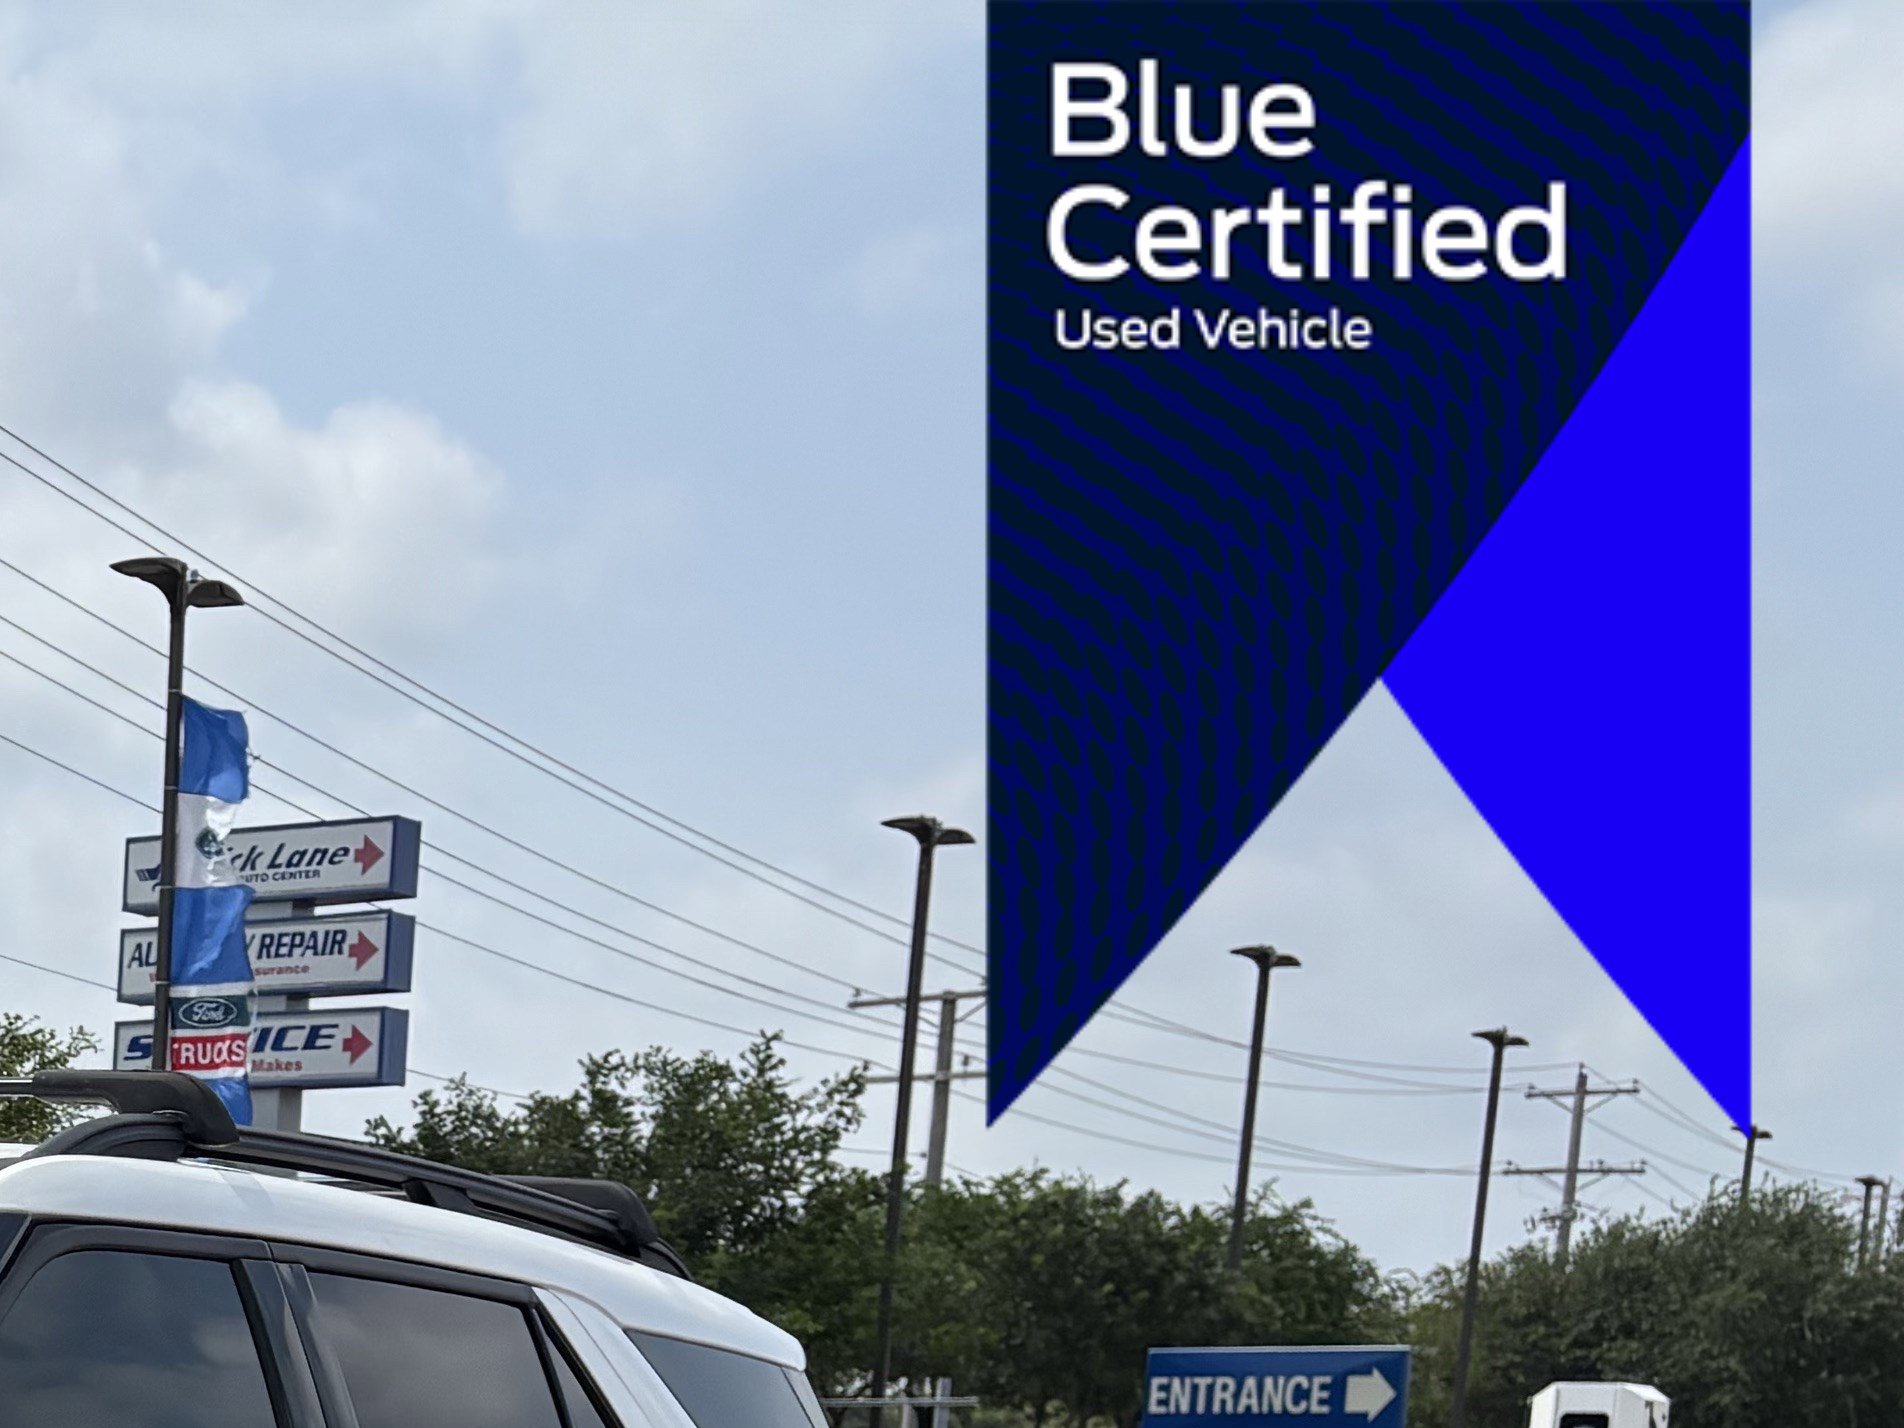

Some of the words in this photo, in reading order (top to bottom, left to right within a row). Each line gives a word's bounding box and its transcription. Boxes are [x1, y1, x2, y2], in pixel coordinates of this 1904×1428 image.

[267, 843, 350, 869] Lane
[272, 870, 320, 882] CENTER
[257, 929, 347, 960] REPAIR
[254, 964, 310, 976] surance
[192, 1003, 225, 1021] Ford
[1148, 1375, 1332, 1415] ENTRANCE
